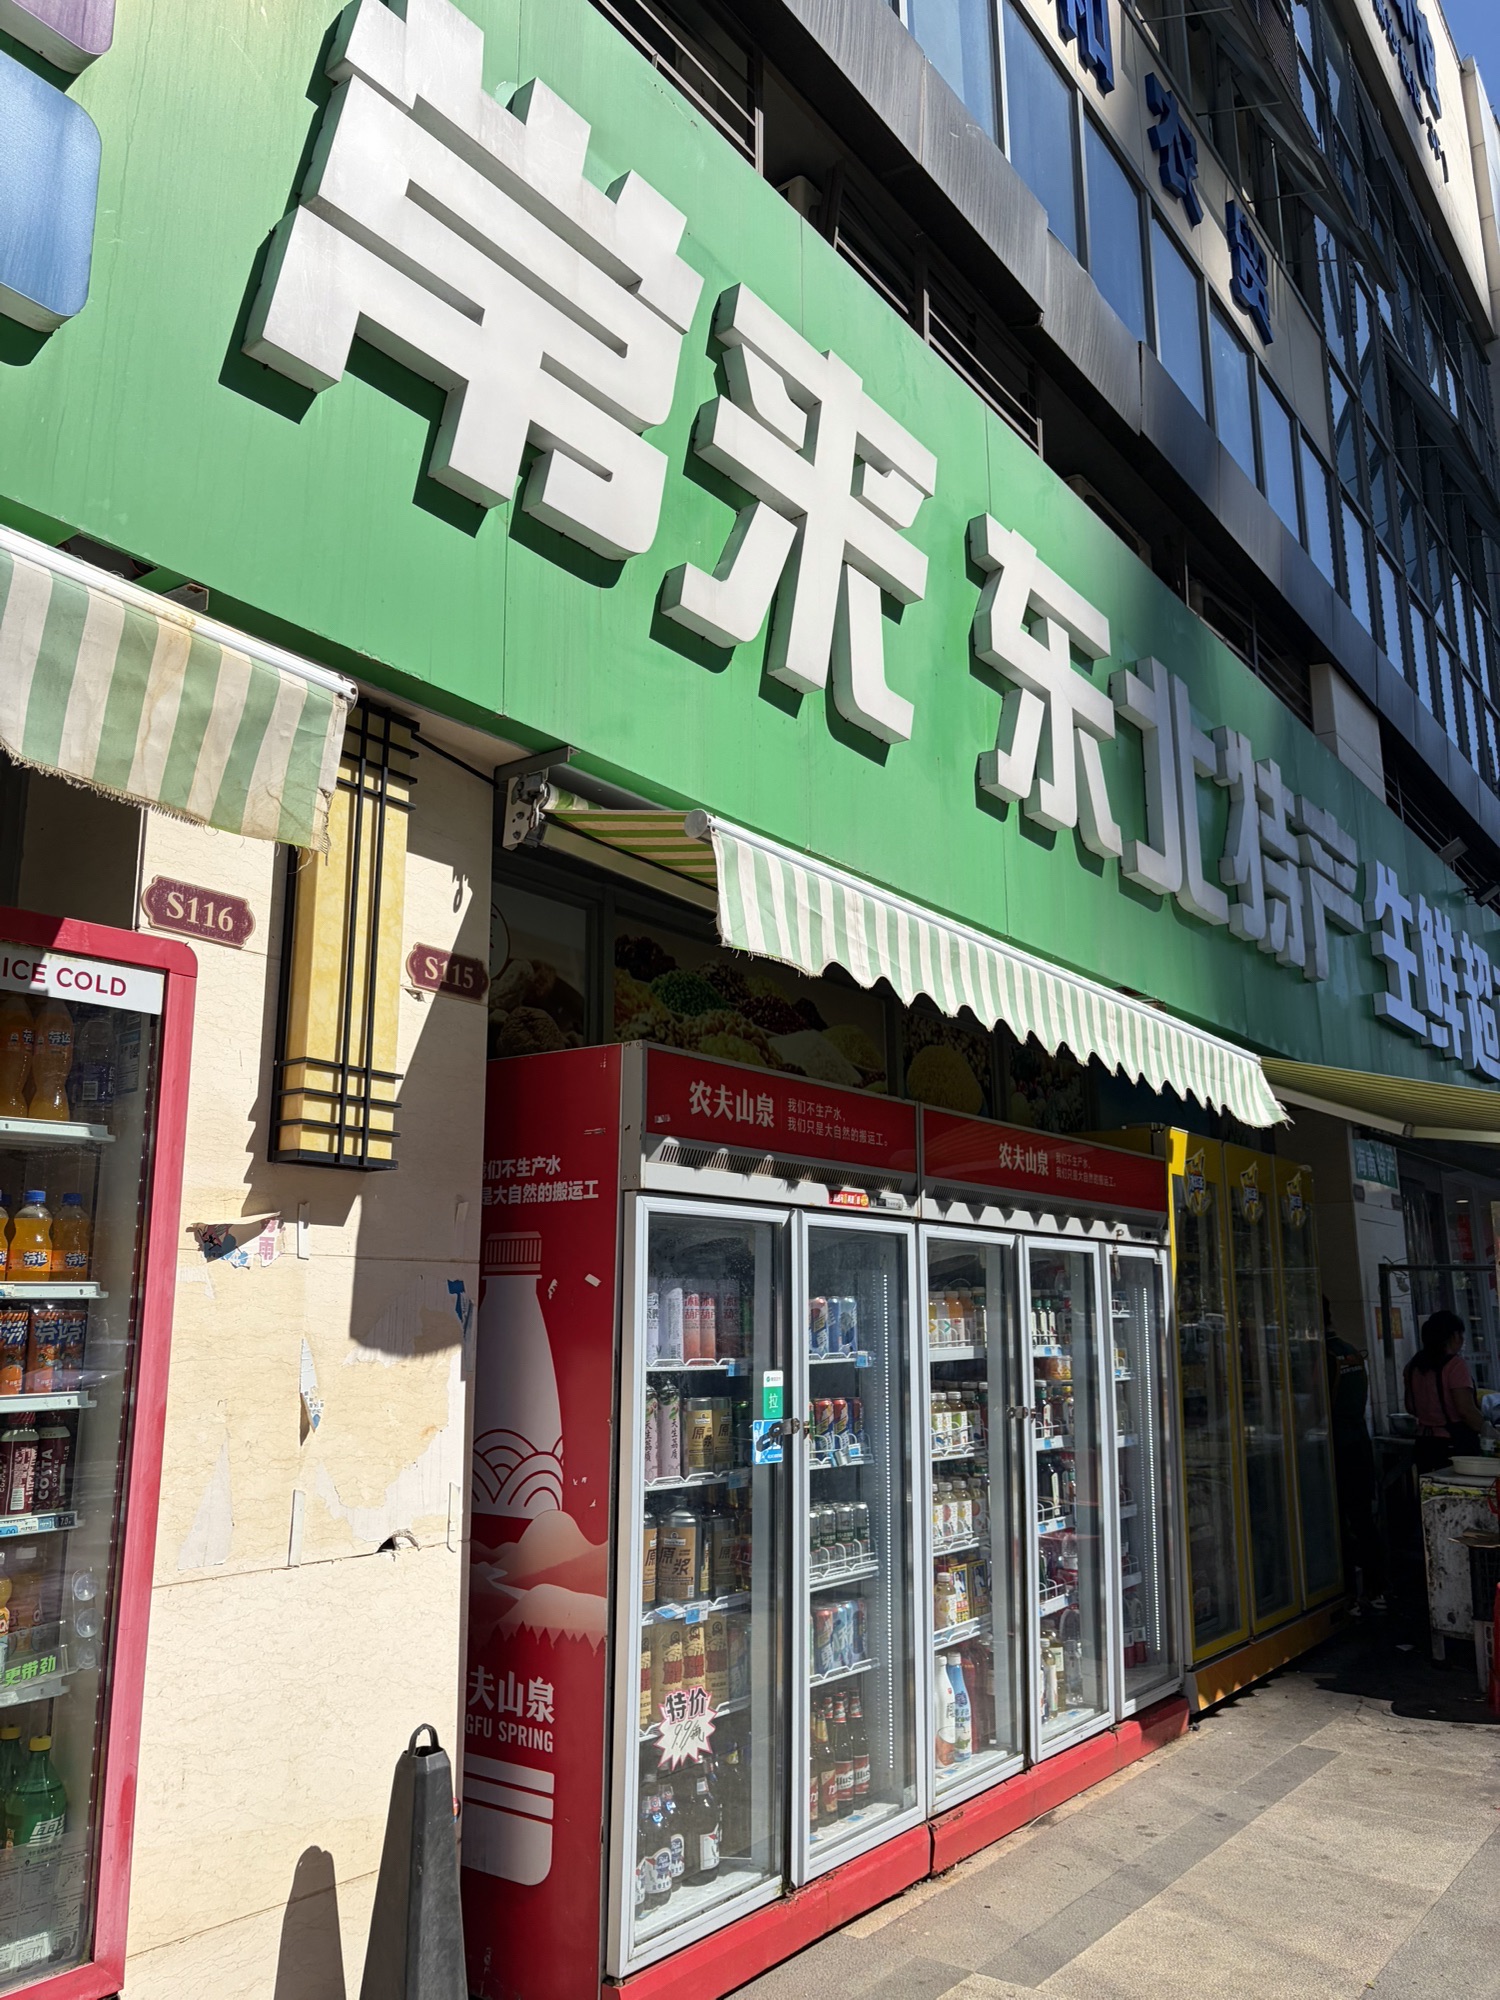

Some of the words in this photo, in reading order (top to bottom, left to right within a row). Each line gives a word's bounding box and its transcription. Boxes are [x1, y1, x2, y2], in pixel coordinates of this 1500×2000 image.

[167, 892, 233, 931] S116
[3, 957, 47, 984] ICE
[56, 967, 127, 996] COLD
[425, 957, 474, 989] S115
[1364, 858, 1500, 1082] 生鲜超
[689, 1080, 775, 1128] 农夫山泉
[999, 1142, 1049, 1176] 农夫山泉
[482, 1180, 599, 1205] 是大自然的搬运工
[24, 1251, 47, 1265] 芬达
[66, 1252, 87, 1265] 芬达
[768, 1393, 778, 1408] 拉
[39, 1448, 53, 1500] COSTA
[52, 1459, 60, 1488] COFFEE
[0, 1655, 57, 1688] 更带劲
[468, 1665, 555, 1724] 夫山泉
[666, 1688, 706, 1721] 特价
[466, 1714, 492, 1738] GFU
[498, 1721, 553, 1753] SPRING
